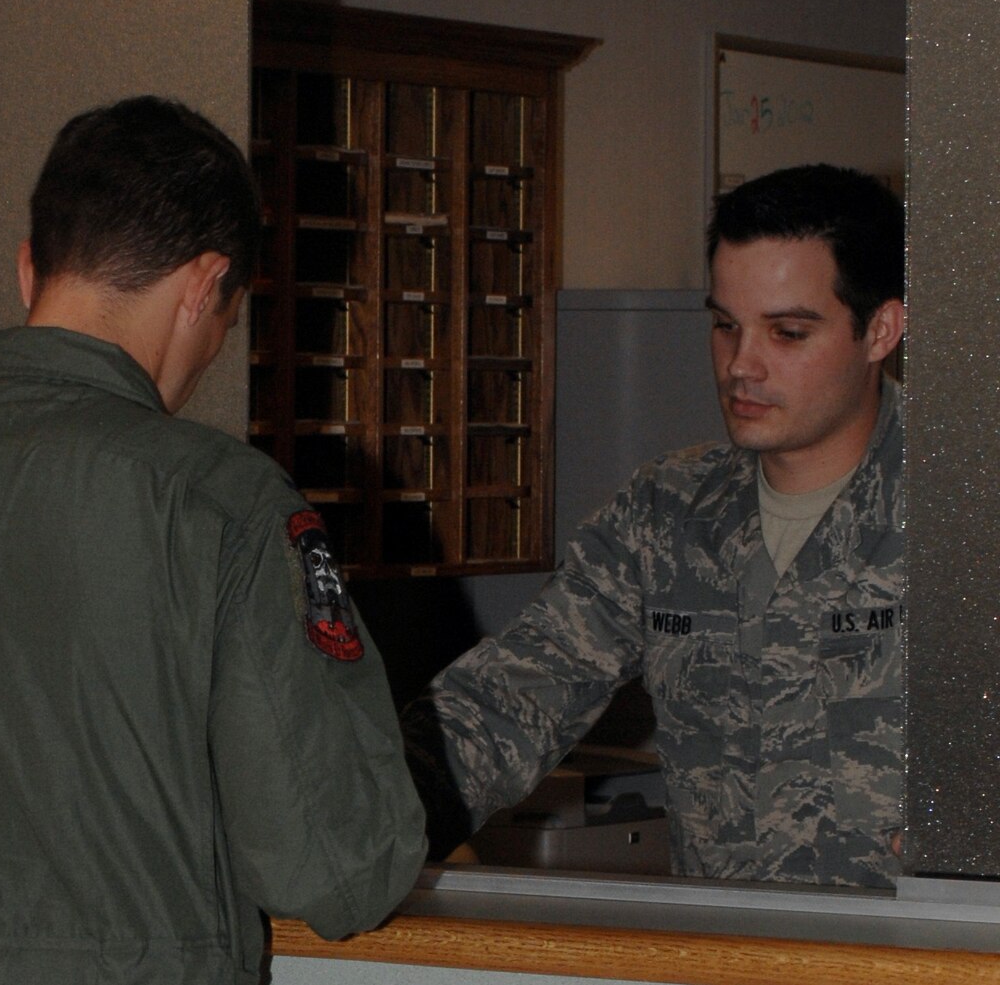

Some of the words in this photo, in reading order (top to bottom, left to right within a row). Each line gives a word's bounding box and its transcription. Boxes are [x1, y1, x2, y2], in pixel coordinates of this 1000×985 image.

[652, 611, 692, 635] WEBB
[832, 612, 860, 633] U.S.
[867, 608, 894, 630] AIR
